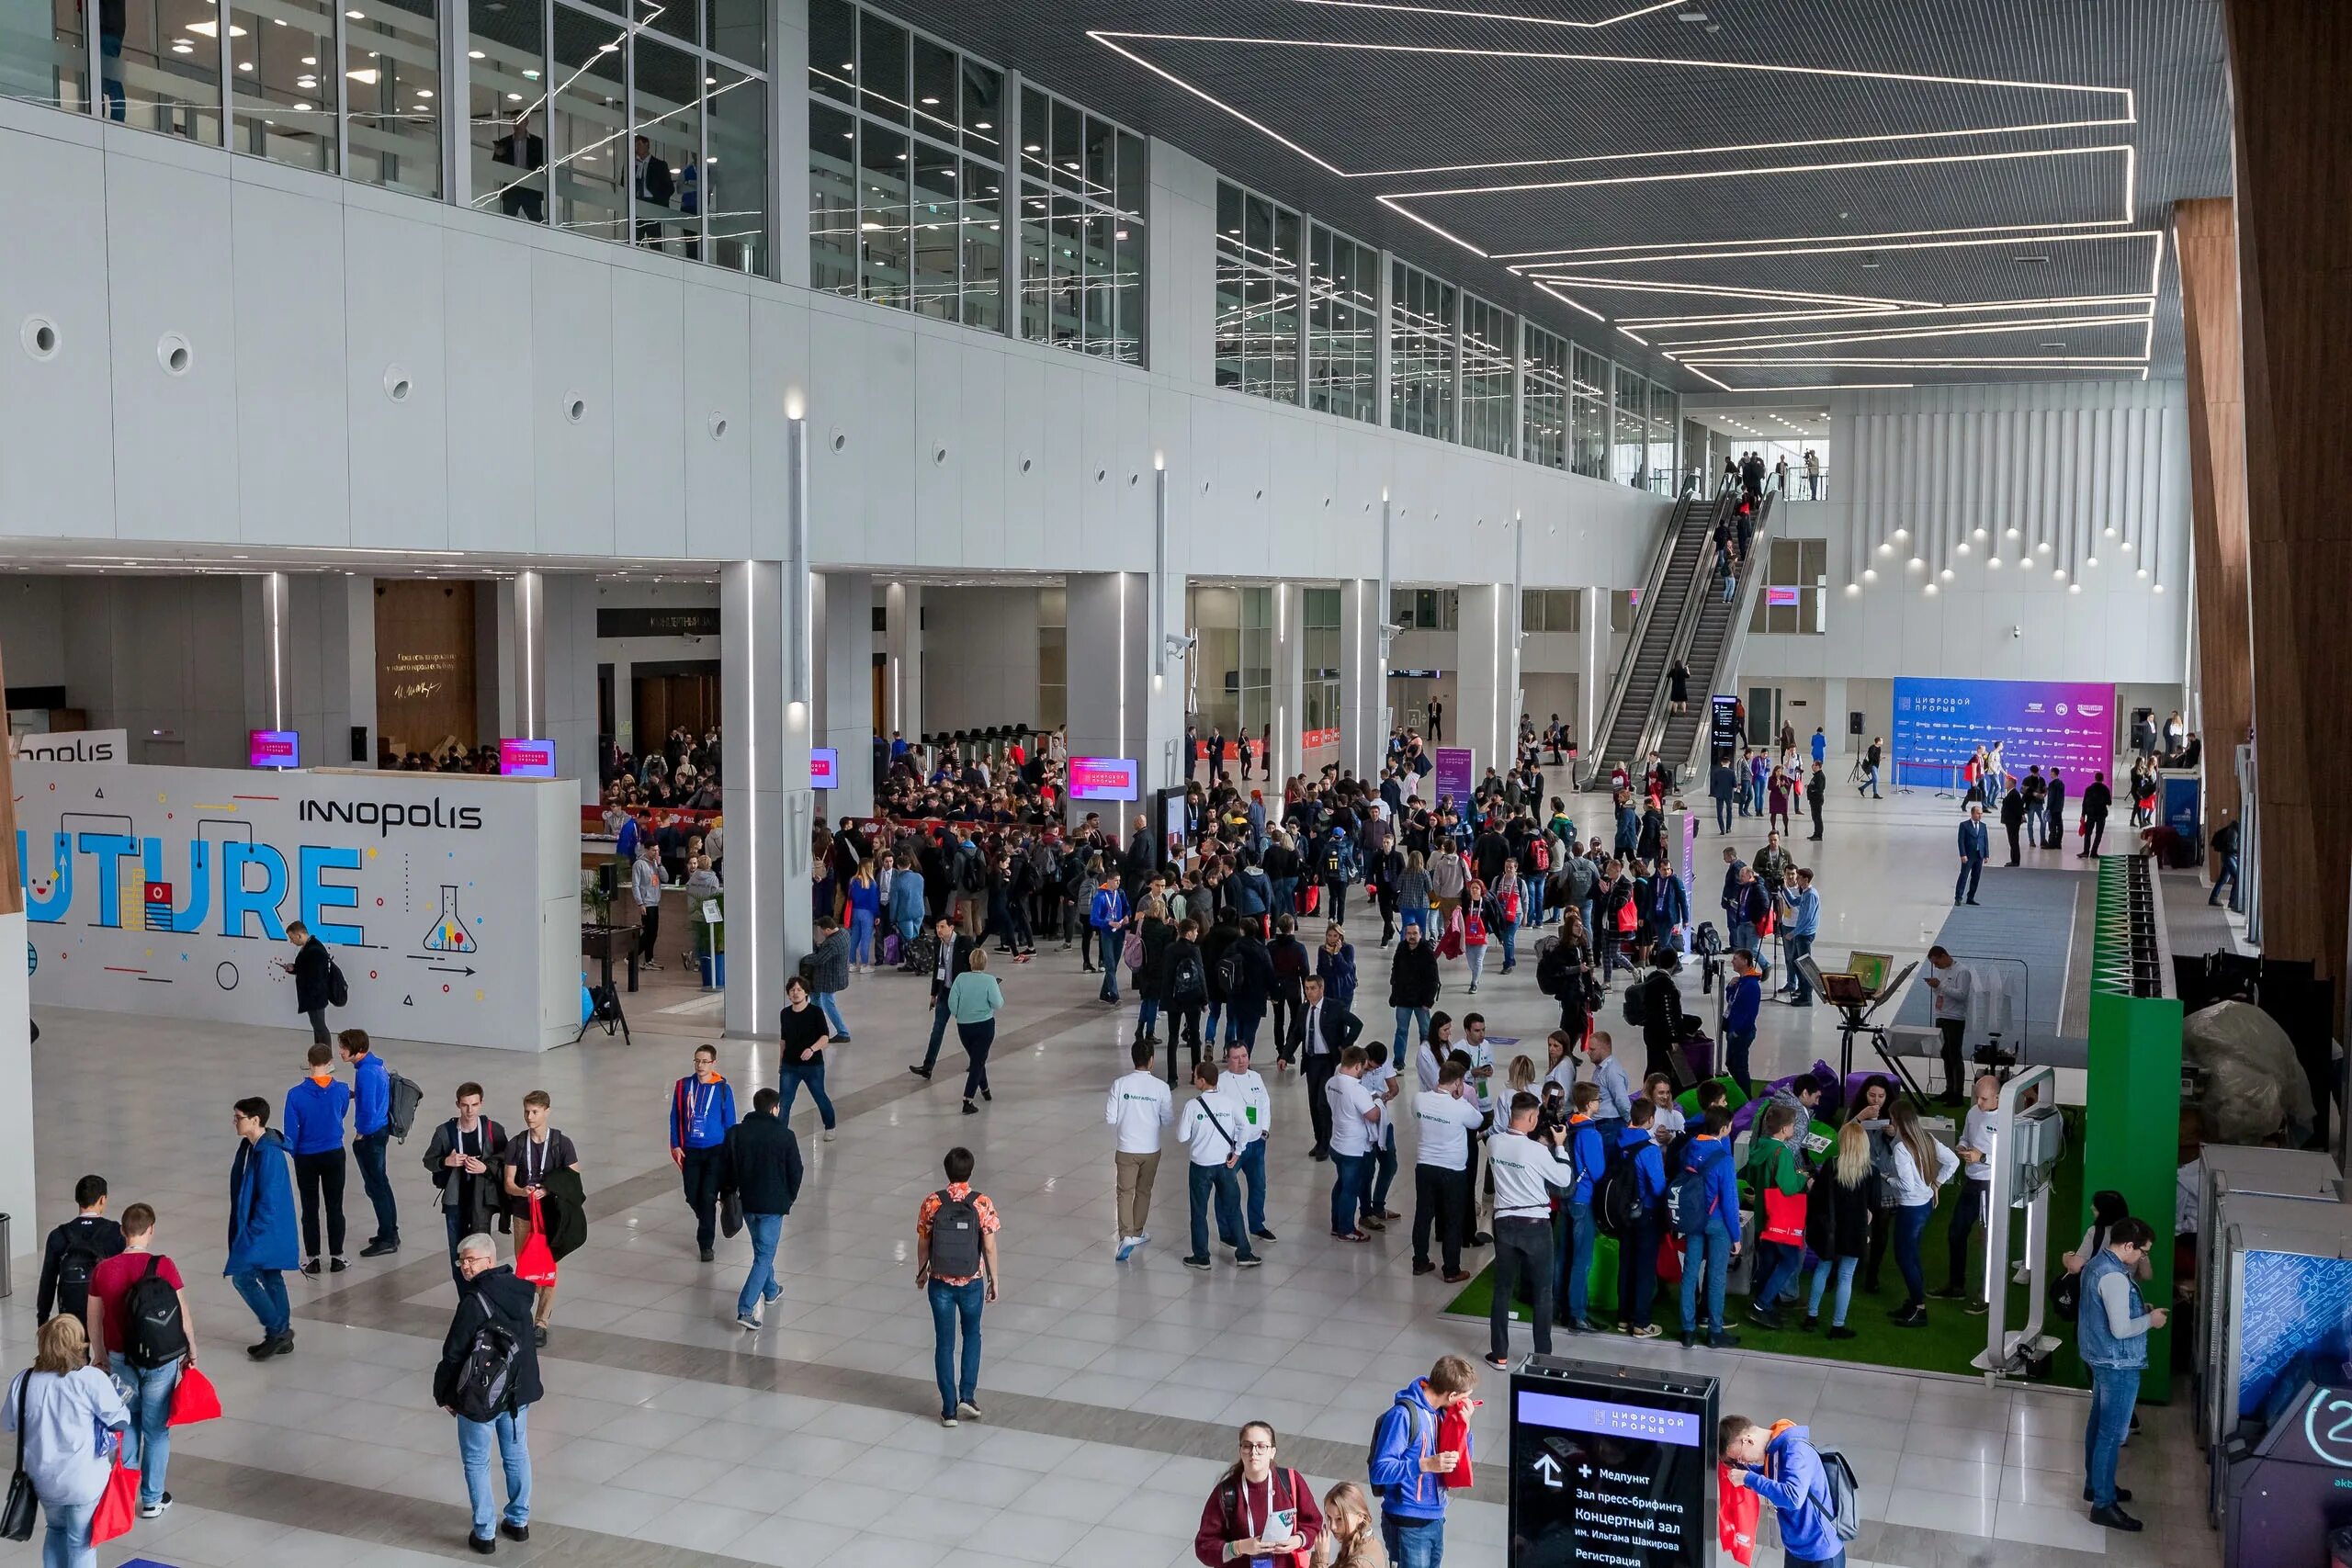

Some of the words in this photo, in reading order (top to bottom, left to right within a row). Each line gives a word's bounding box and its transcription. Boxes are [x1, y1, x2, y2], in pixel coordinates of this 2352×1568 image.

[1915, 697, 1971, 705] ЦИФРОВОЙ
[1611, 1411, 1684, 1427] ЦИФРОВОЙ
[1611, 1420, 1665, 1434] ПРОРЫВ
[1600, 1468, 1650, 1485] Медпункт
[1576, 1488, 1596, 1500] Зал
[1598, 1493, 1684, 1514] пресс-брифинга
[1575, 1507, 1655, 1530] Концертный
[1657, 1521, 1680, 1535] зал
[1575, 1528, 1589, 1538] им.
[1591, 1529, 1630, 1544] Ильгама
[1632, 1535, 1680, 1551] Шакирова
[1576, 1548, 1642, 1568] Регистрация
